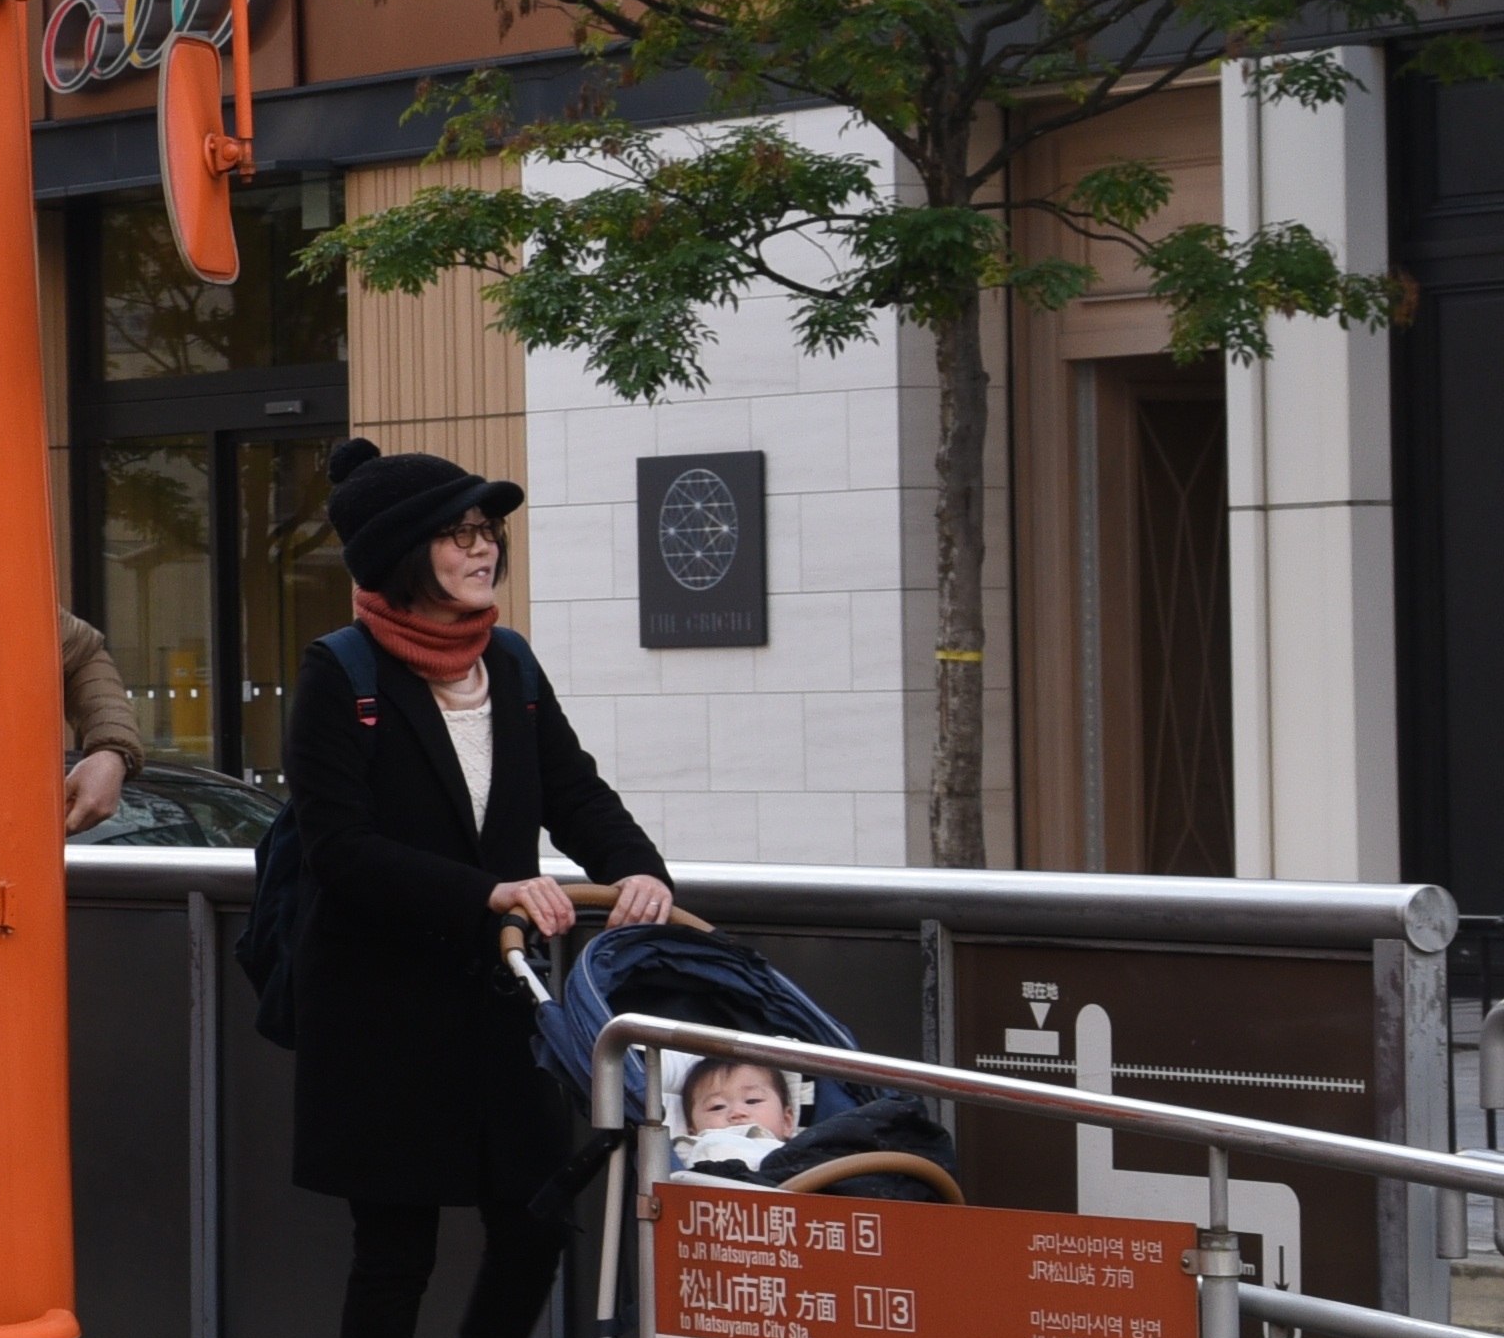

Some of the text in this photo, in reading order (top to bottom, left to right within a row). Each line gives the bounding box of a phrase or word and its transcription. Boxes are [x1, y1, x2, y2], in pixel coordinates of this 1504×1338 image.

[1021, 981, 1059, 1001] 現在地
[678, 1201, 876, 1252] JR松山駅 方面 5
[678, 1241, 803, 1269] to JR Matsuyama Sta.
[1028, 1233, 1163, 1263] JR마쓰야마역 방면
[1028, 1260, 1134, 1289] JR松山站 方向
[679, 1267, 787, 1318] 松山市駅
[796, 1290, 837, 1323] 方面
[680, 1311, 691, 1329] to
[694, 1313, 759, 1338] Matsuyama
[1030, 1309, 1123, 1338] 마쓰야마시역
